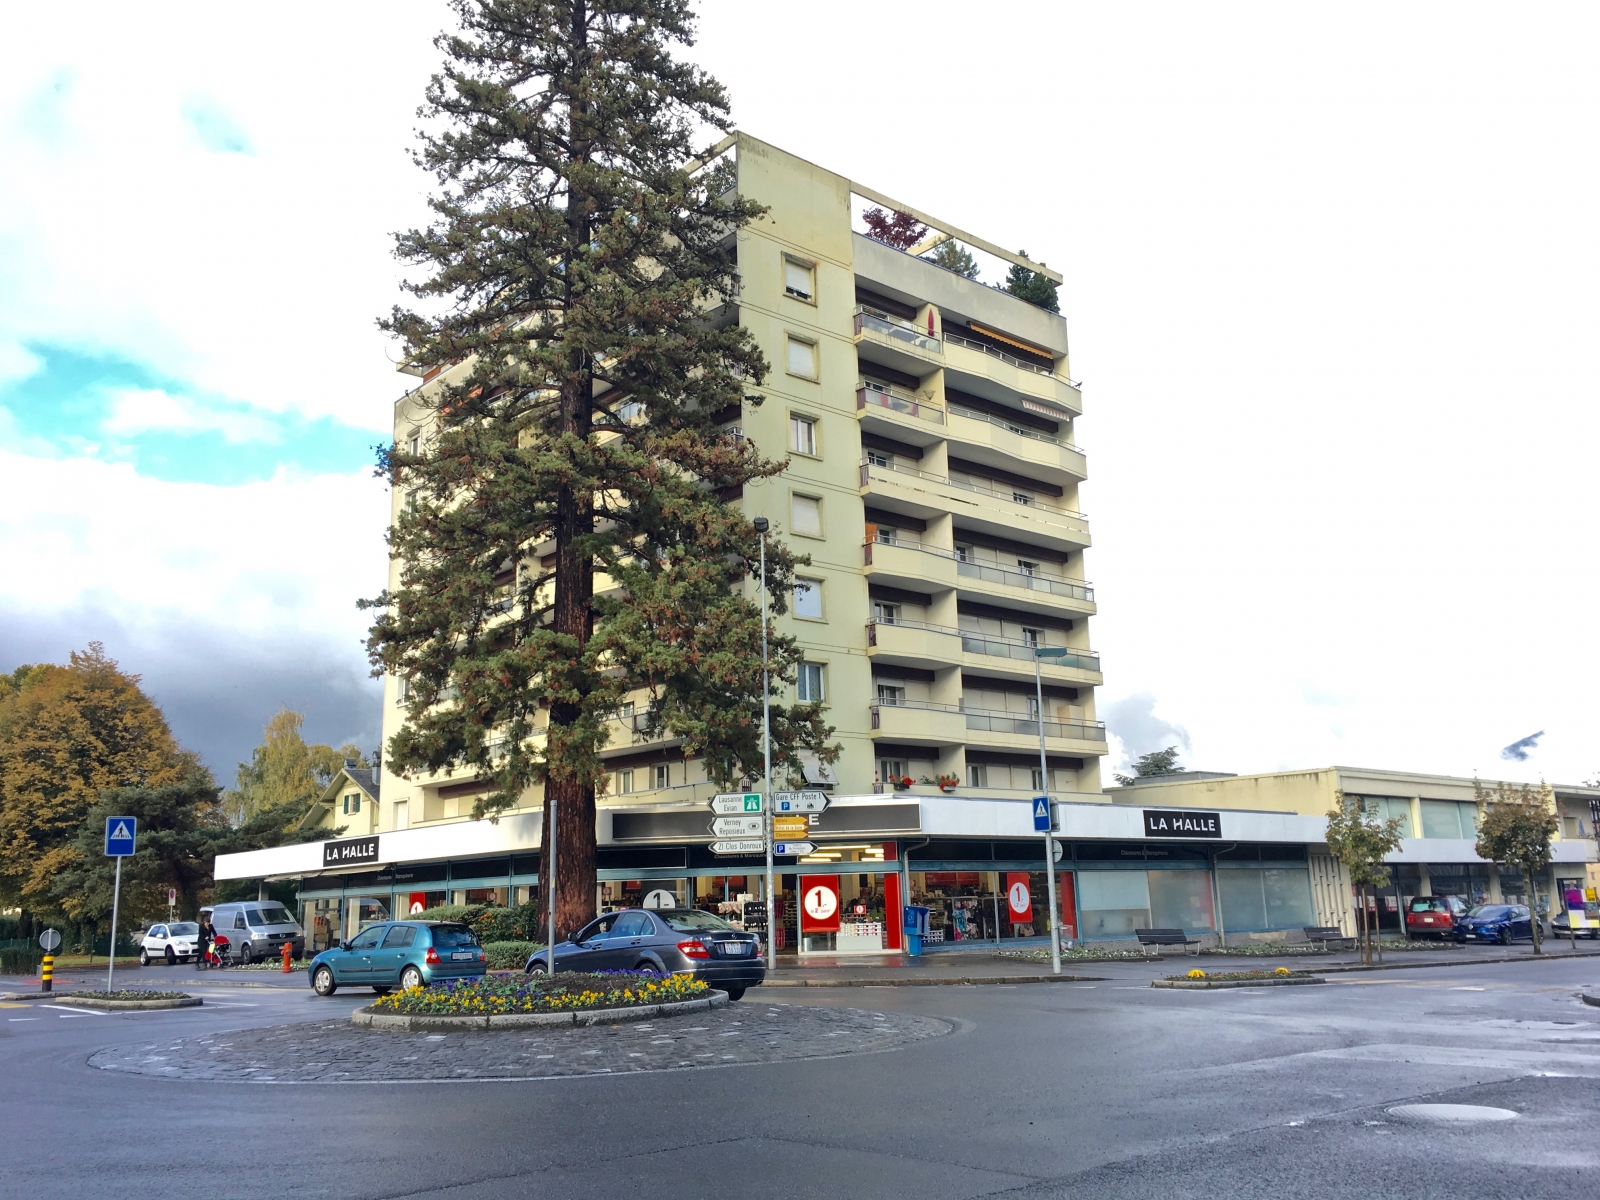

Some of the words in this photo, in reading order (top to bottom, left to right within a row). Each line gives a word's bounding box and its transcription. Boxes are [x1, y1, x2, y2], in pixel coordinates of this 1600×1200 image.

[1150, 818, 1168, 830] LA
[1172, 818, 1216, 832] HALLE
[326, 848, 338, 860] LA
[342, 843, 374, 858] HALLE
[726, 842, 738, 850] Clos
[740, 842, 762, 850] Donroux
